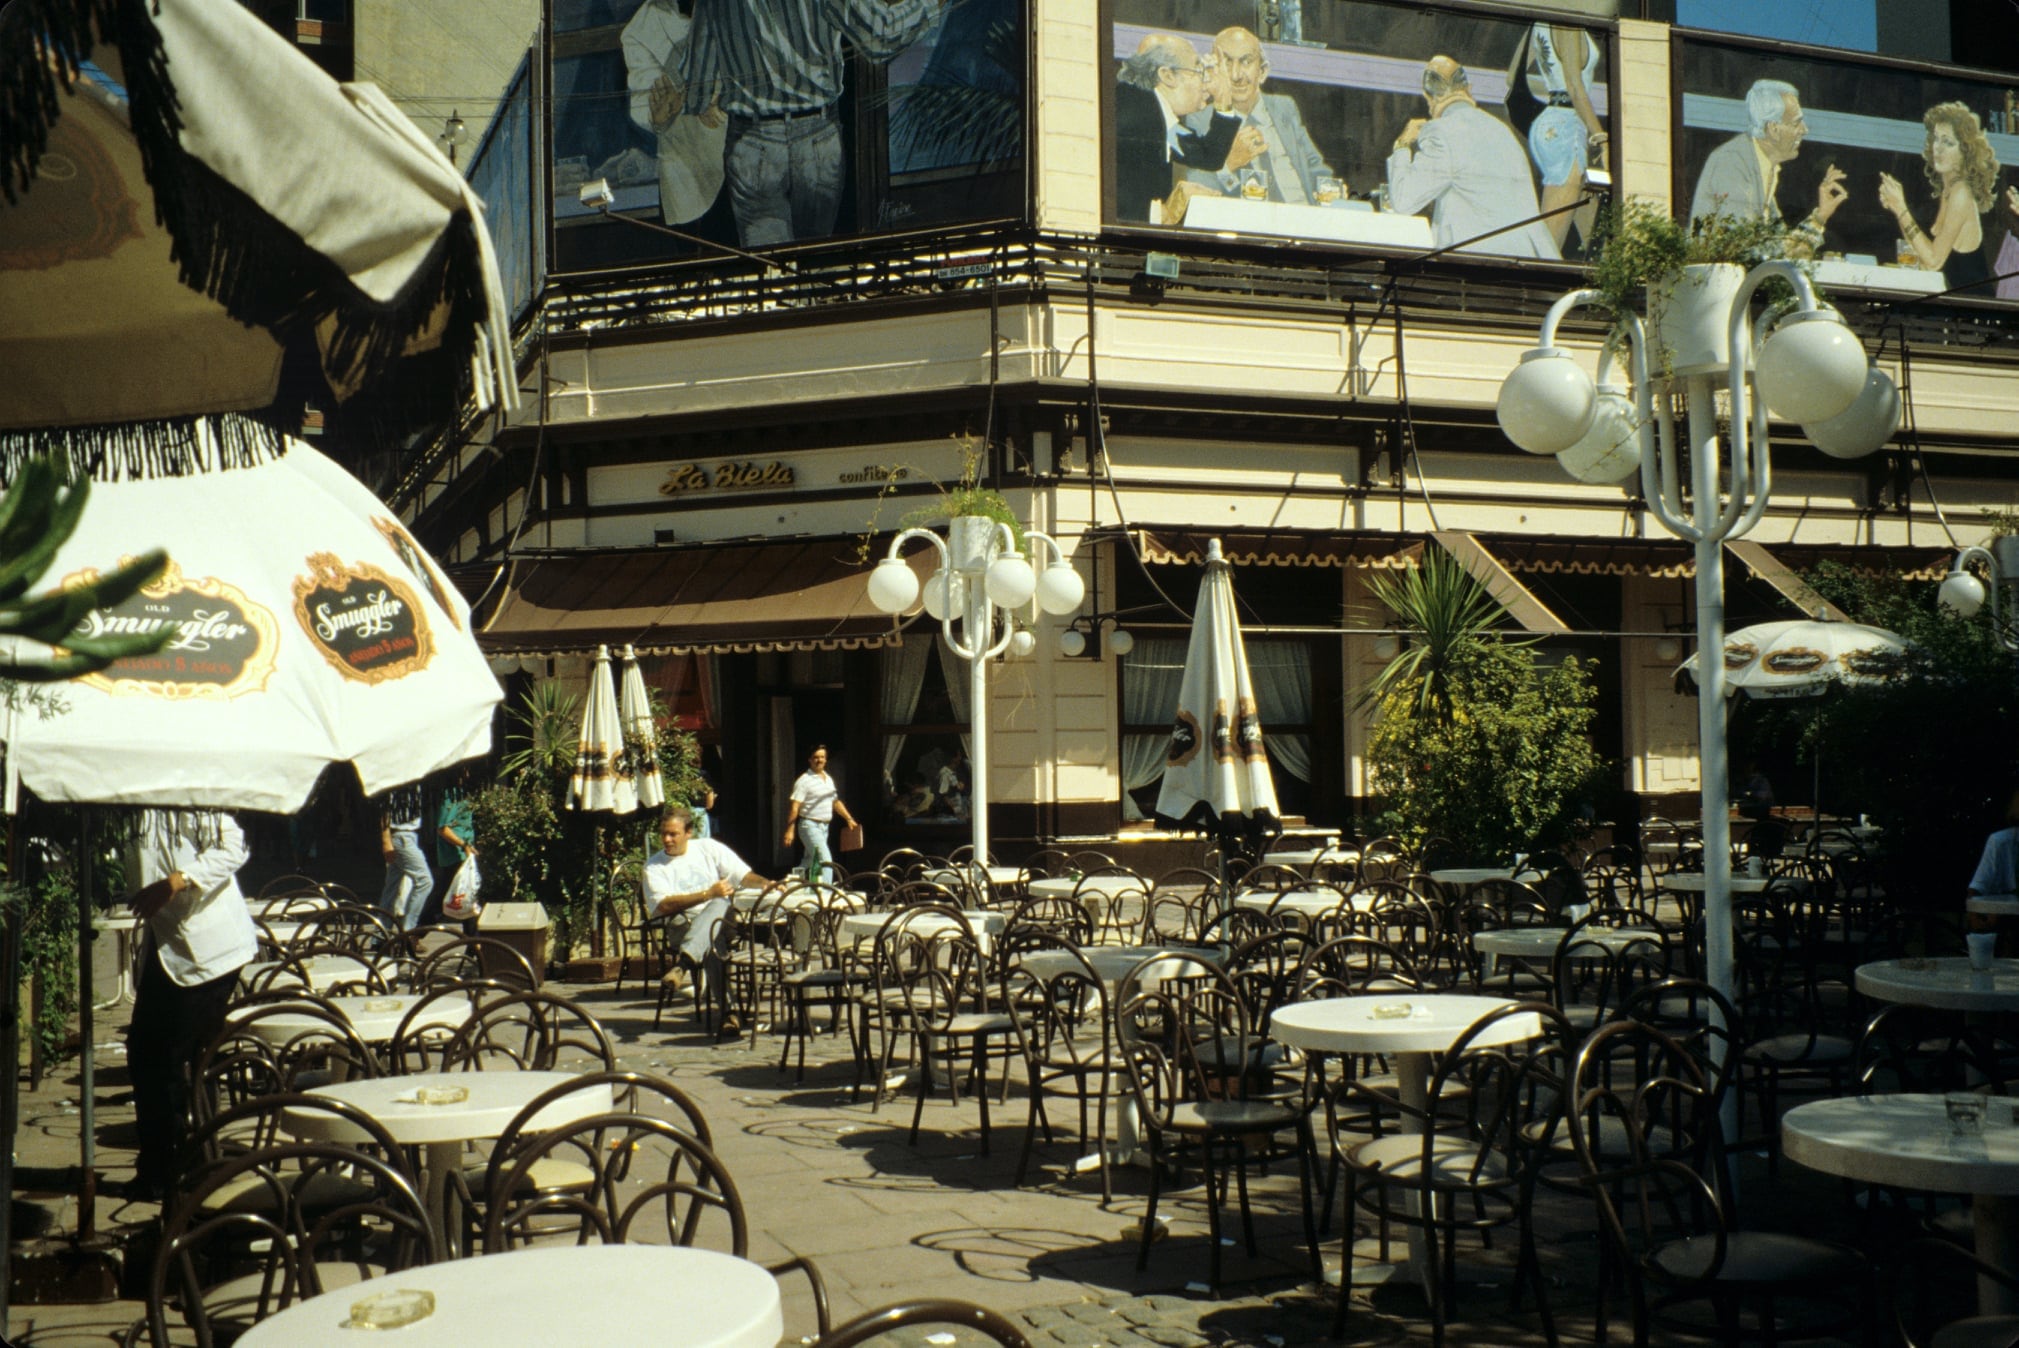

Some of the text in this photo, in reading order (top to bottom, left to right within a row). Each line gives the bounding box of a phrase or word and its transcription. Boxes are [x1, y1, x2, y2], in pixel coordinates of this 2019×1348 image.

[659, 461, 794, 495] La Biela
[145, 604, 170, 613] OLD
[316, 589, 402, 641] Smuggler
[77, 608, 247, 651] Smugler
